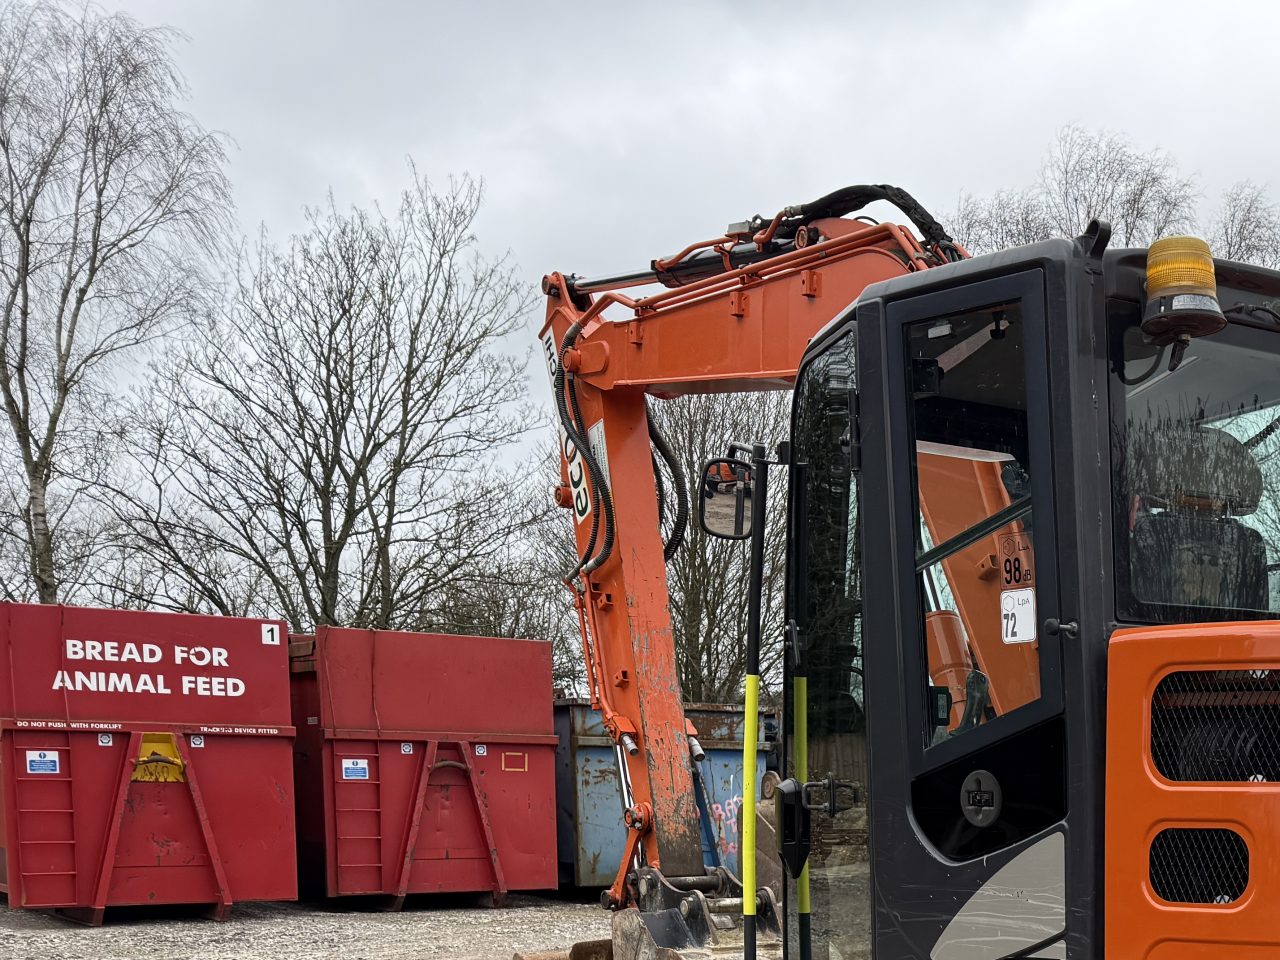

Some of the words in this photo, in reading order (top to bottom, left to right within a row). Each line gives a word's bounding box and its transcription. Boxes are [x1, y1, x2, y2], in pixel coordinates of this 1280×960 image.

[1004, 557, 1021, 584] 98
[1022, 569, 1032, 582] dB
[266, 626, 276, 642] 1
[1003, 612, 1018, 638] 72
[66, 639, 162, 663] BREAD
[174, 645, 229, 667] FOR
[52, 670, 171, 694] ANIMAL
[182, 676, 246, 697] FEED
